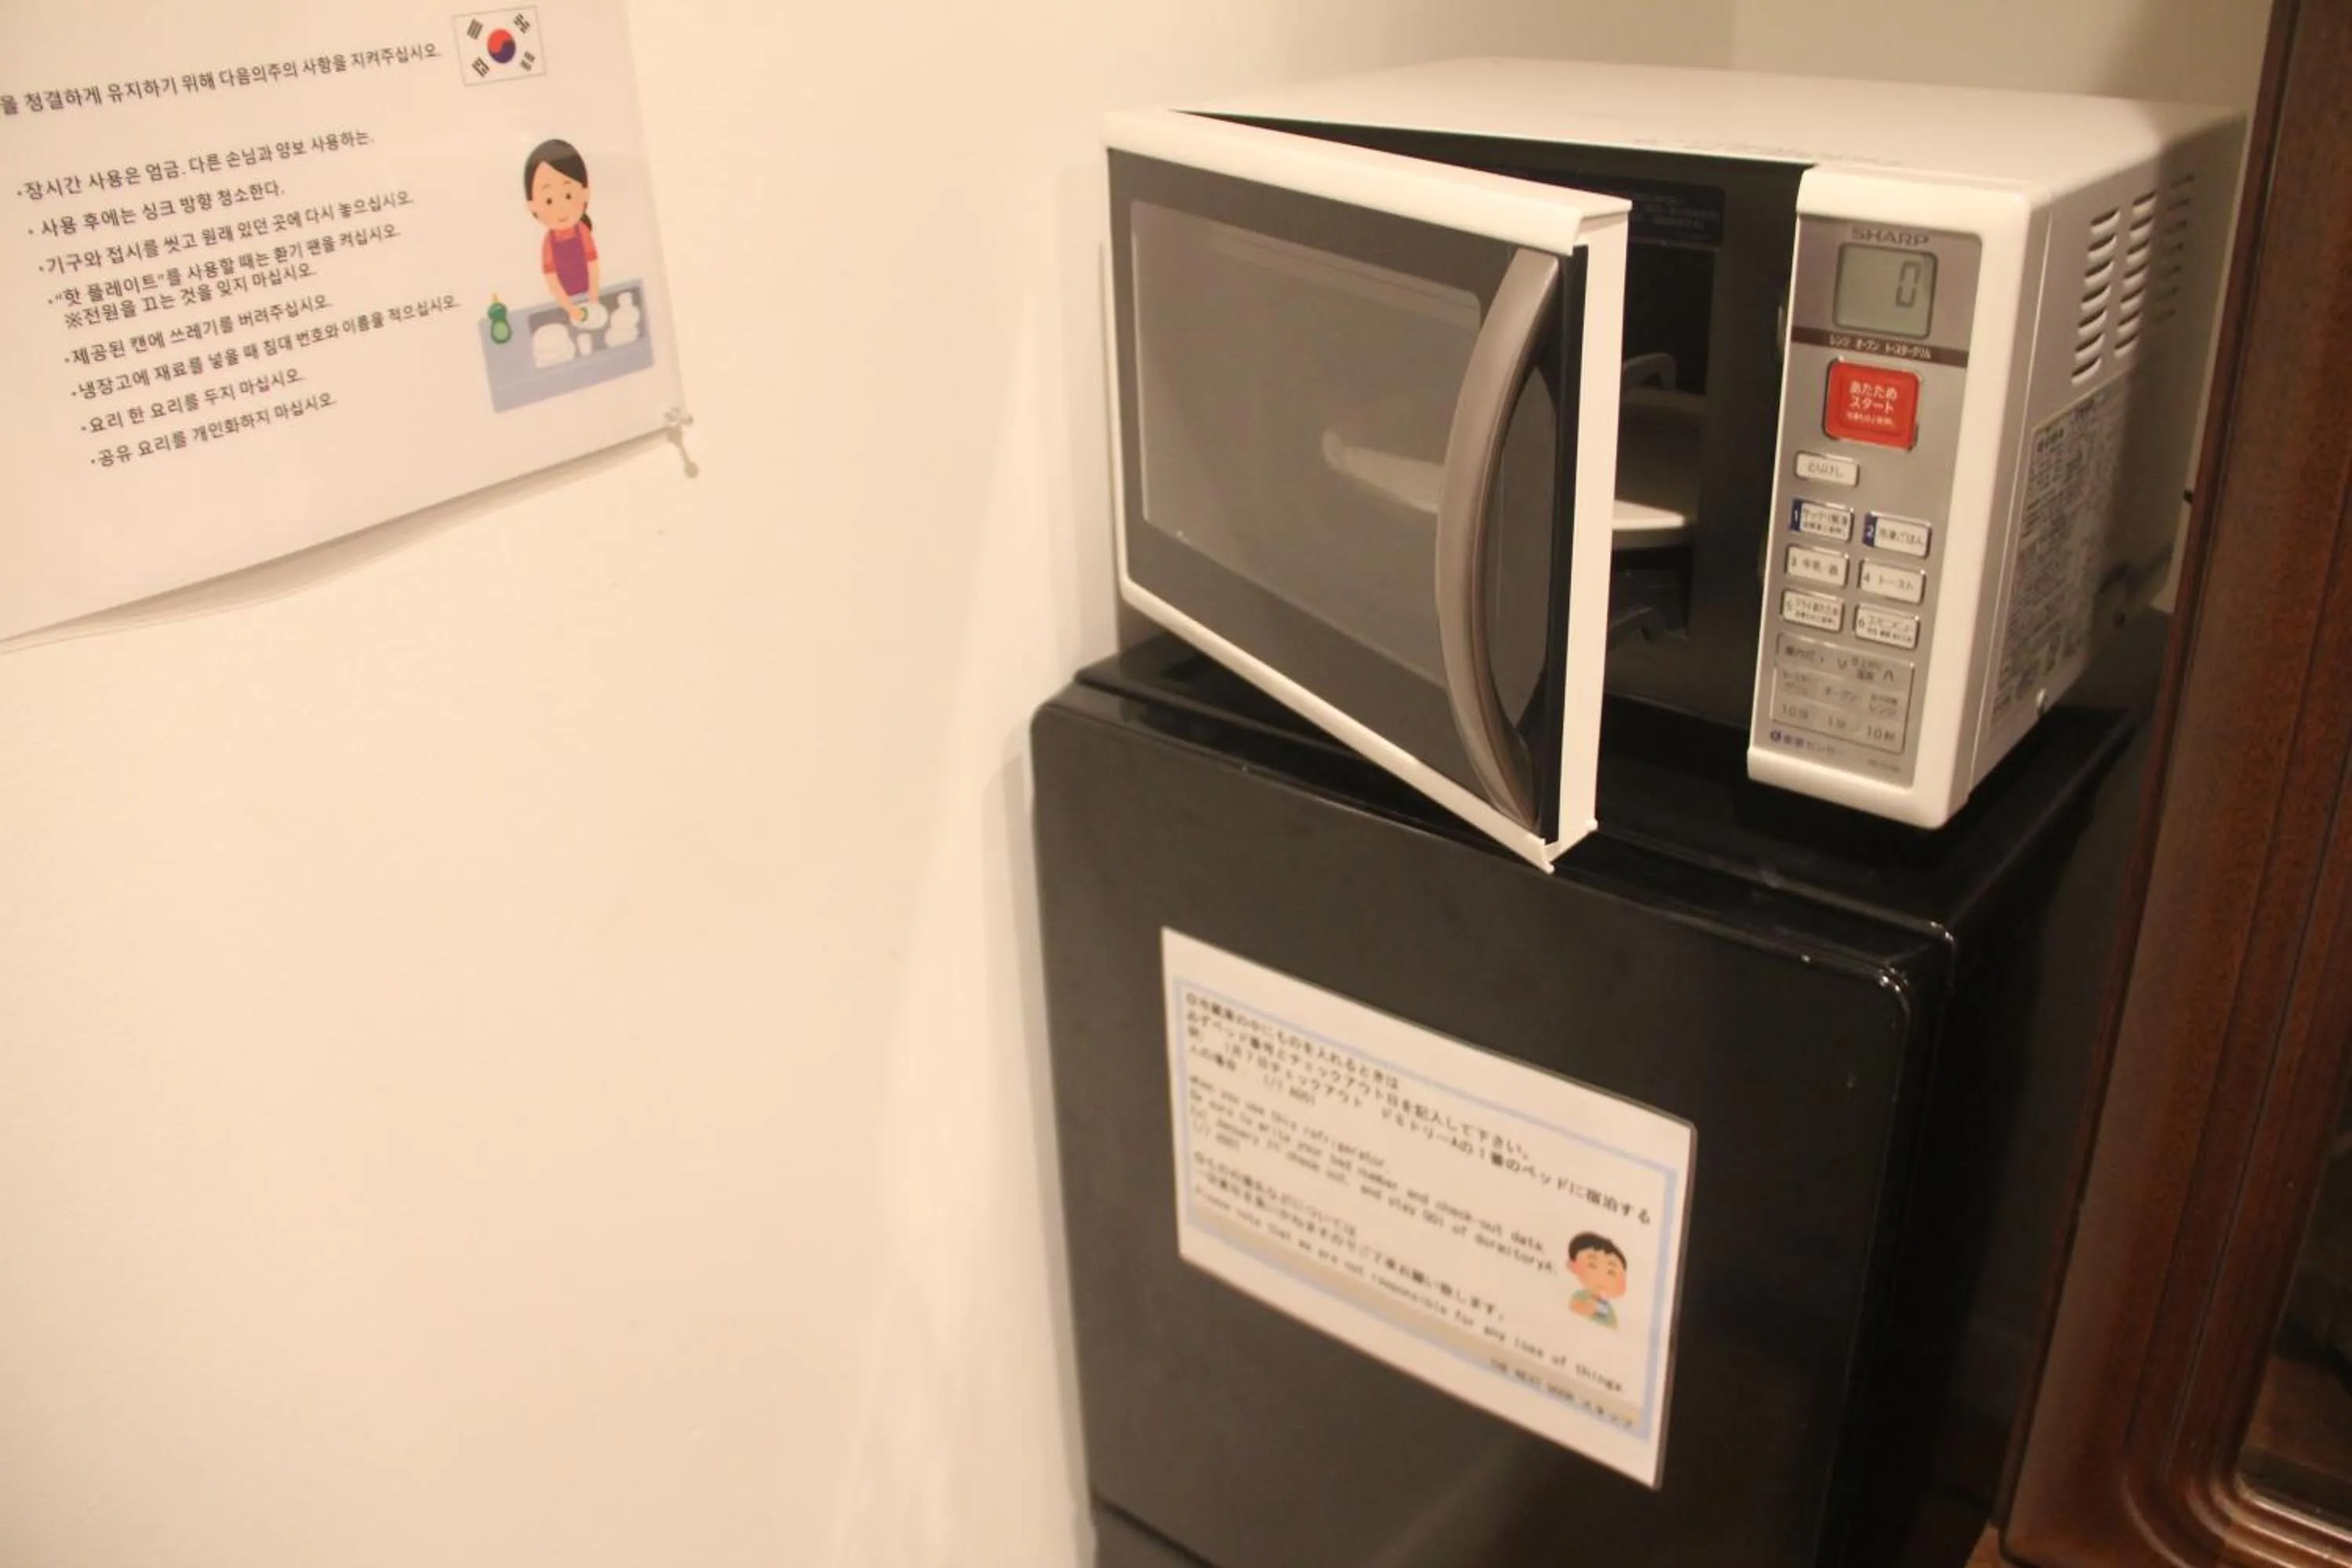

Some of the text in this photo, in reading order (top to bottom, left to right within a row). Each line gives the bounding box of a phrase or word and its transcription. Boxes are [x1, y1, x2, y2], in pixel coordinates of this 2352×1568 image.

[24, 83, 104, 114] 청결하게
[105, 74, 180, 103] 유지하기
[180, 71, 217, 93] 위해
[299, 53, 349, 78] 사항을
[349, 40, 443, 70] 지켜주십시오.
[86, 165, 142, 192] 사용은
[143, 158, 187, 182] 엄금.
[187, 152, 223, 175] 다른
[223, 143, 274, 169] 손님과
[274, 138, 307, 159] 양보
[310, 127, 376, 154] 사용하는.
[39, 214, 78, 238] 사용
[81, 204, 138, 230] 후에는
[141, 198, 176, 221] 싱크
[216, 179, 285, 207] 청소한다.
[104, 238, 160, 265] 접시를
[162, 230, 198, 253] 씻고
[200, 224, 234, 246] 원래
[236, 217, 269, 238] 있던
[270, 209, 303, 231] 곳에
[303, 204, 335, 224] 다시
[1849, 227, 1929, 246] SHARP
[185, 256, 234, 282] 사용할
[237, 249, 270, 270] 때는
[272, 241, 304, 263] 환기
[141, 291, 176, 313] 끄는
[180, 283, 213, 305] 것을
[216, 275, 248, 297] 잊지
[249, 260, 319, 290] 마십시오.
[1896, 260, 1920, 308] 0
[129, 330, 165, 354] 캔에
[168, 314, 234, 344] 쓰레기를
[153, 358, 204, 383] 재료를
[206, 349, 239, 371] 넣을
[241, 344, 260, 362] 때
[262, 335, 293, 357] 침대
[294, 323, 339, 348] 번호와
[340, 310, 386, 336] 이름을
[128, 406, 145, 425] 한
[150, 392, 200, 419] 요리를
[204, 384, 235, 405] 두지
[1849, 380, 1898, 401] あたため
[1849, 395, 1894, 414] スタート
[136, 429, 188, 459] 요리를
[1866, 524, 1874, 539] 2
[1360, 1181, 1381, 1200] and
[1388, 1194, 1416, 1215] stay
[1450, 1220, 1468, 1237] of
[1406, 1185, 1429, 1203] and
[1454, 1308, 1475, 1328] for
[1483, 1323, 1506, 1344] any
[1550, 1350, 1567, 1369] of
